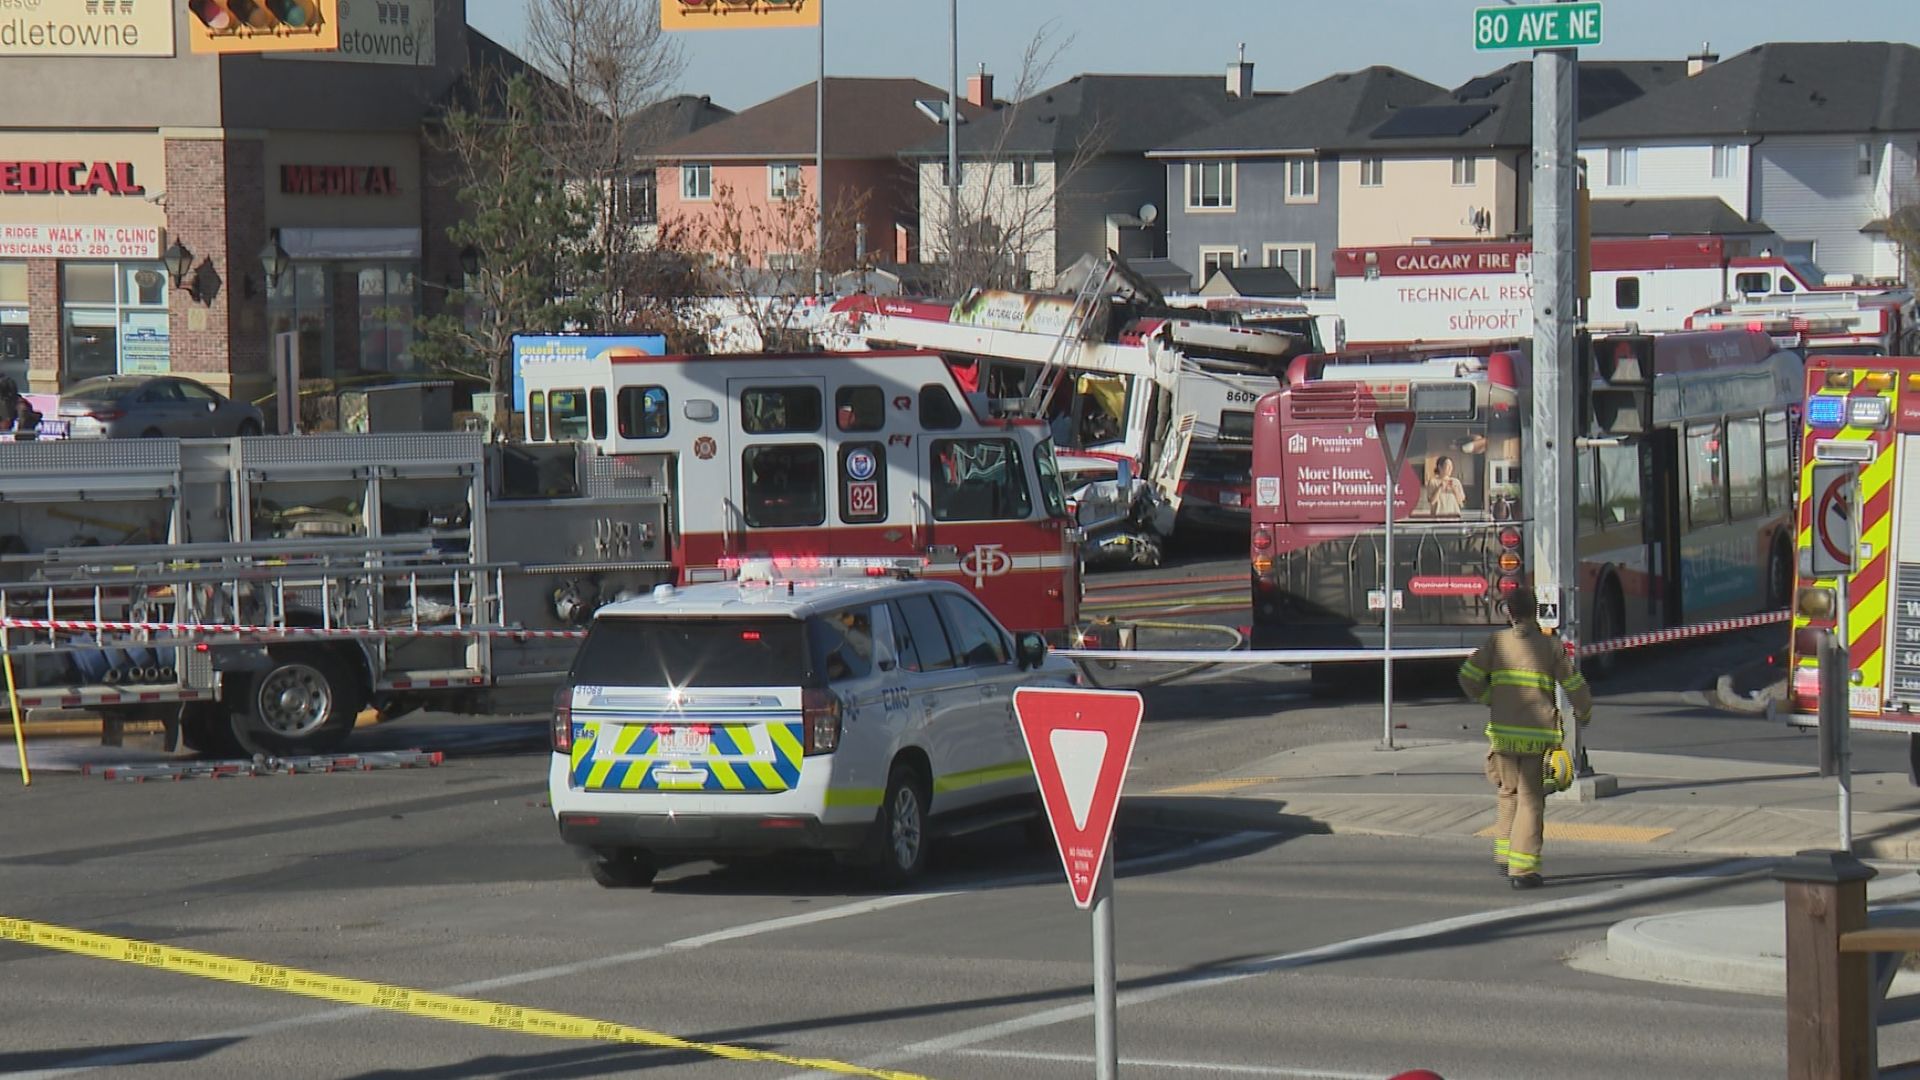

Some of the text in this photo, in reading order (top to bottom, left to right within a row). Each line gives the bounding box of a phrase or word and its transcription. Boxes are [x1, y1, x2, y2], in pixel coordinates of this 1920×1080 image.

[1, 19, 138, 46] dletowne
[1479, 10, 1598, 43] 80 AVE NE
[338, 29, 414, 56] etowne
[281, 165, 402, 194] MEDICAL
[6, 228, 38, 239] RIDGE
[48, 228, 83, 242] WALK
[93, 229, 106, 242] IN
[116, 229, 156, 243] CLINIC
[58, 245, 78, 254] 403
[120, 246, 148, 255] 0179
[1396, 254, 1472, 270] CALGARY
[1478, 253, 1511, 268] FIRE
[1398, 286, 1490, 302] TECHNICAL
[1449, 314, 1519, 330] SUPPORT
[1226, 391, 1257, 402] 8609
[1311, 436, 1363, 447] Prominent
[1297, 466, 1374, 480] More Home.
[1297, 481, 1403, 496] More Prominet.
[853, 486, 873, 510] 32
[1297, 500, 1316, 508] Design
[882, 687, 909, 711] EMS
[575, 729, 595, 738] EMS
